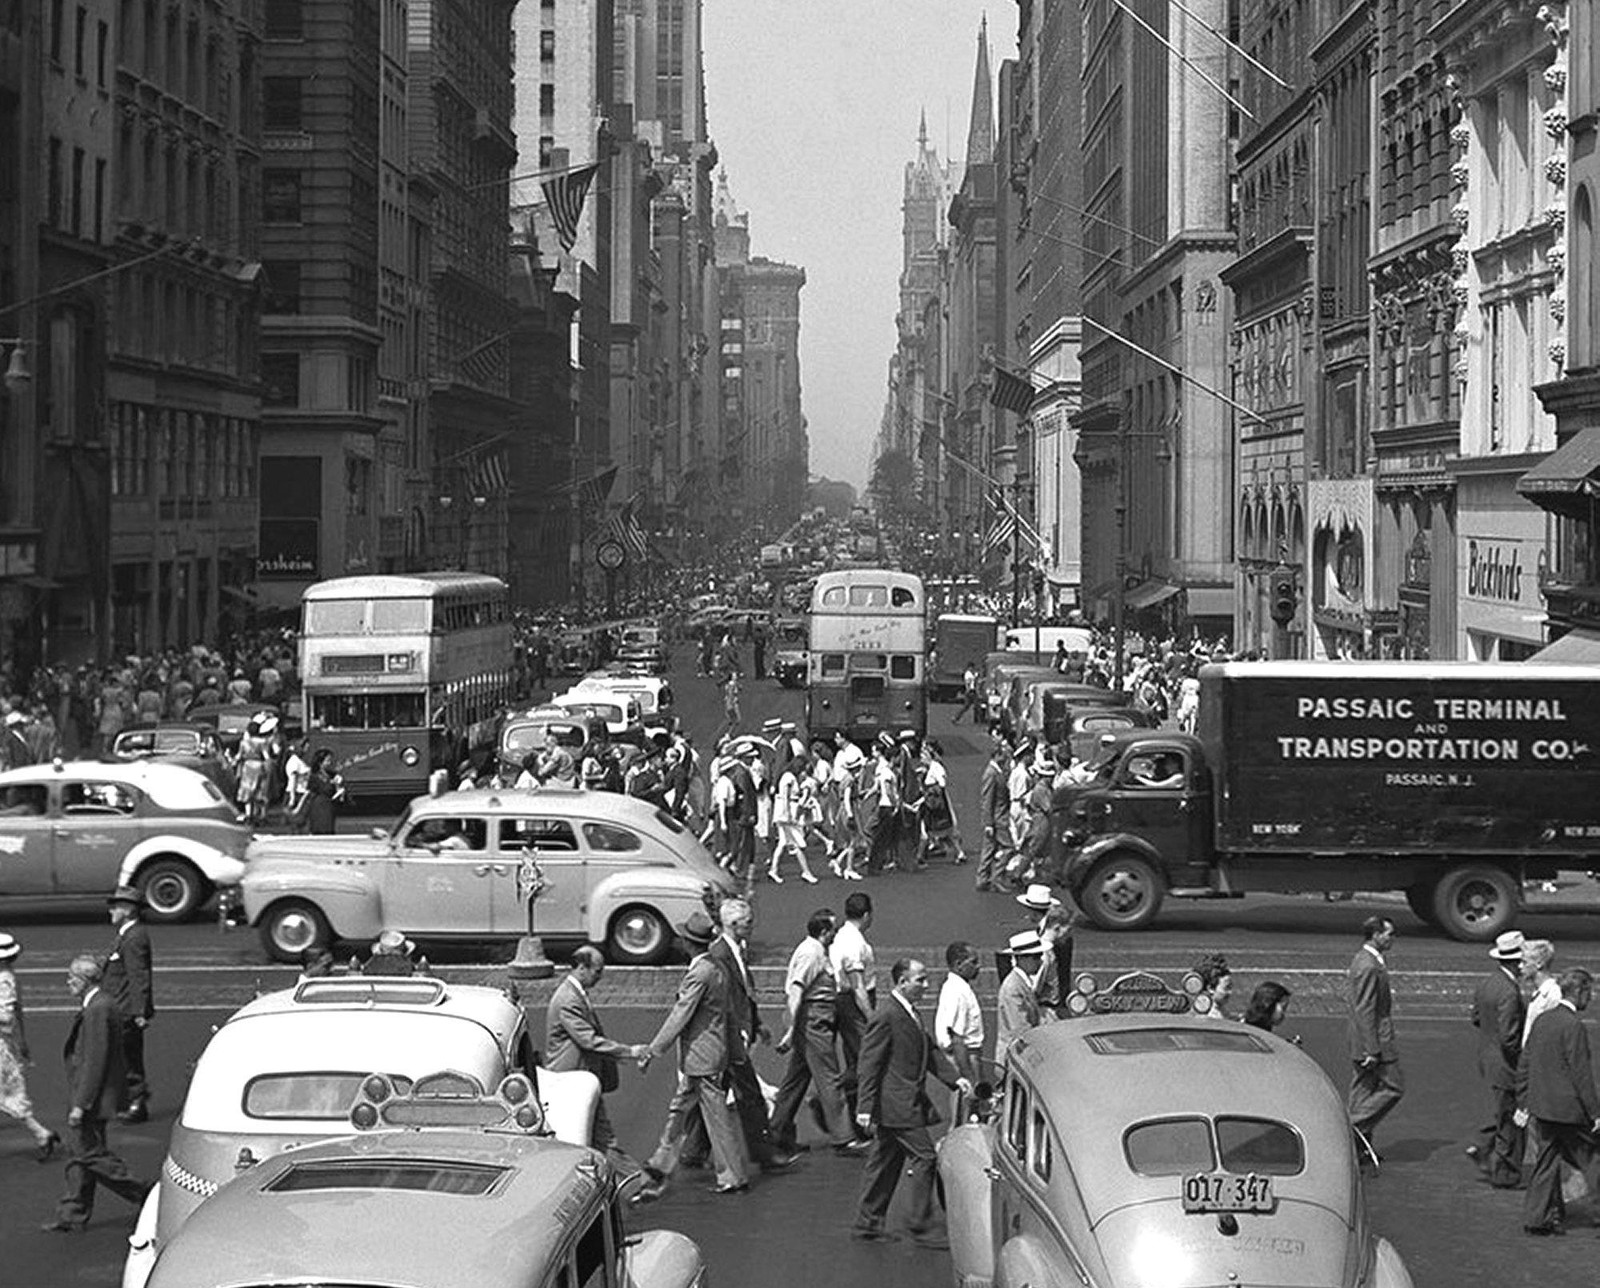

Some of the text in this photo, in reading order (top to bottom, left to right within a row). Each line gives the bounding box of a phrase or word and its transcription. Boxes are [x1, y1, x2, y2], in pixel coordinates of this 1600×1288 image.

[1298, 698, 1566, 720] PASSAIC TERMINAL
[1414, 723, 1448, 734] AND
[1277, 737, 1518, 759] TRANSPORTATION
[1275, 824, 1302, 835] YORK
